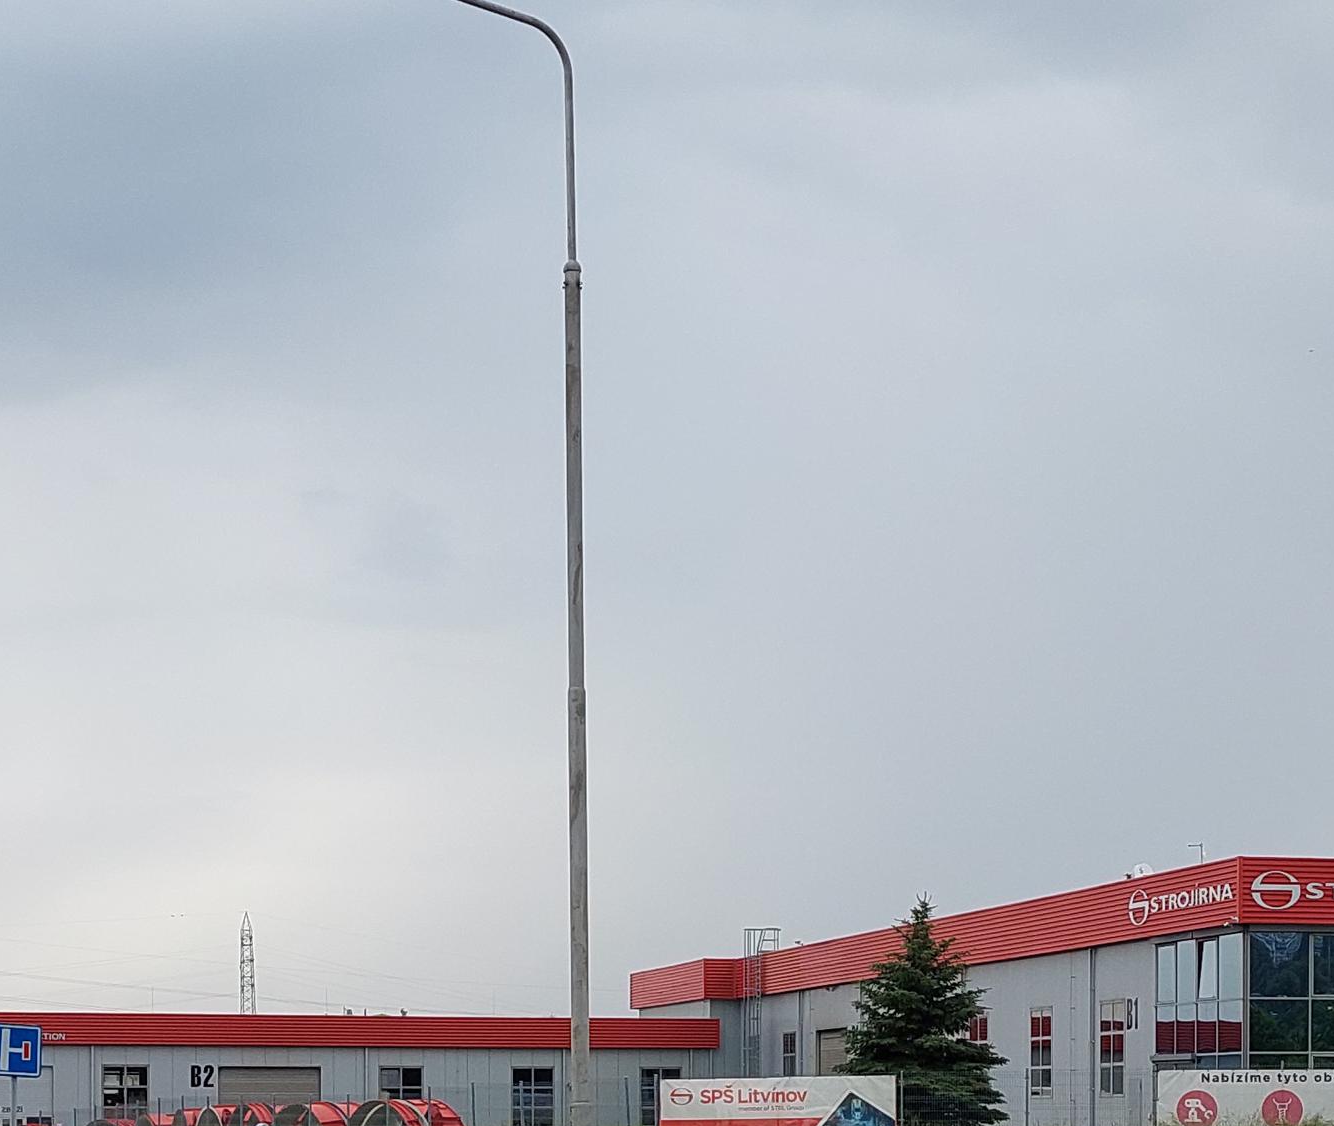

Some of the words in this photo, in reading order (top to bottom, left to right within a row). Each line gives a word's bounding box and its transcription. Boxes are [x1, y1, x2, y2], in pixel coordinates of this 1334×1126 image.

[1150, 883, 1233, 913] STROJÍRNA
[1127, 997, 1138, 1030] B1
[190, 1064, 215, 1088] B2
[1201, 1072, 1271, 1084] Nabízíme
[1277, 1073, 1308, 1085] tyto
[700, 1084, 734, 1104] SPŠ
[738, 1086, 808, 1104] Litvínov
